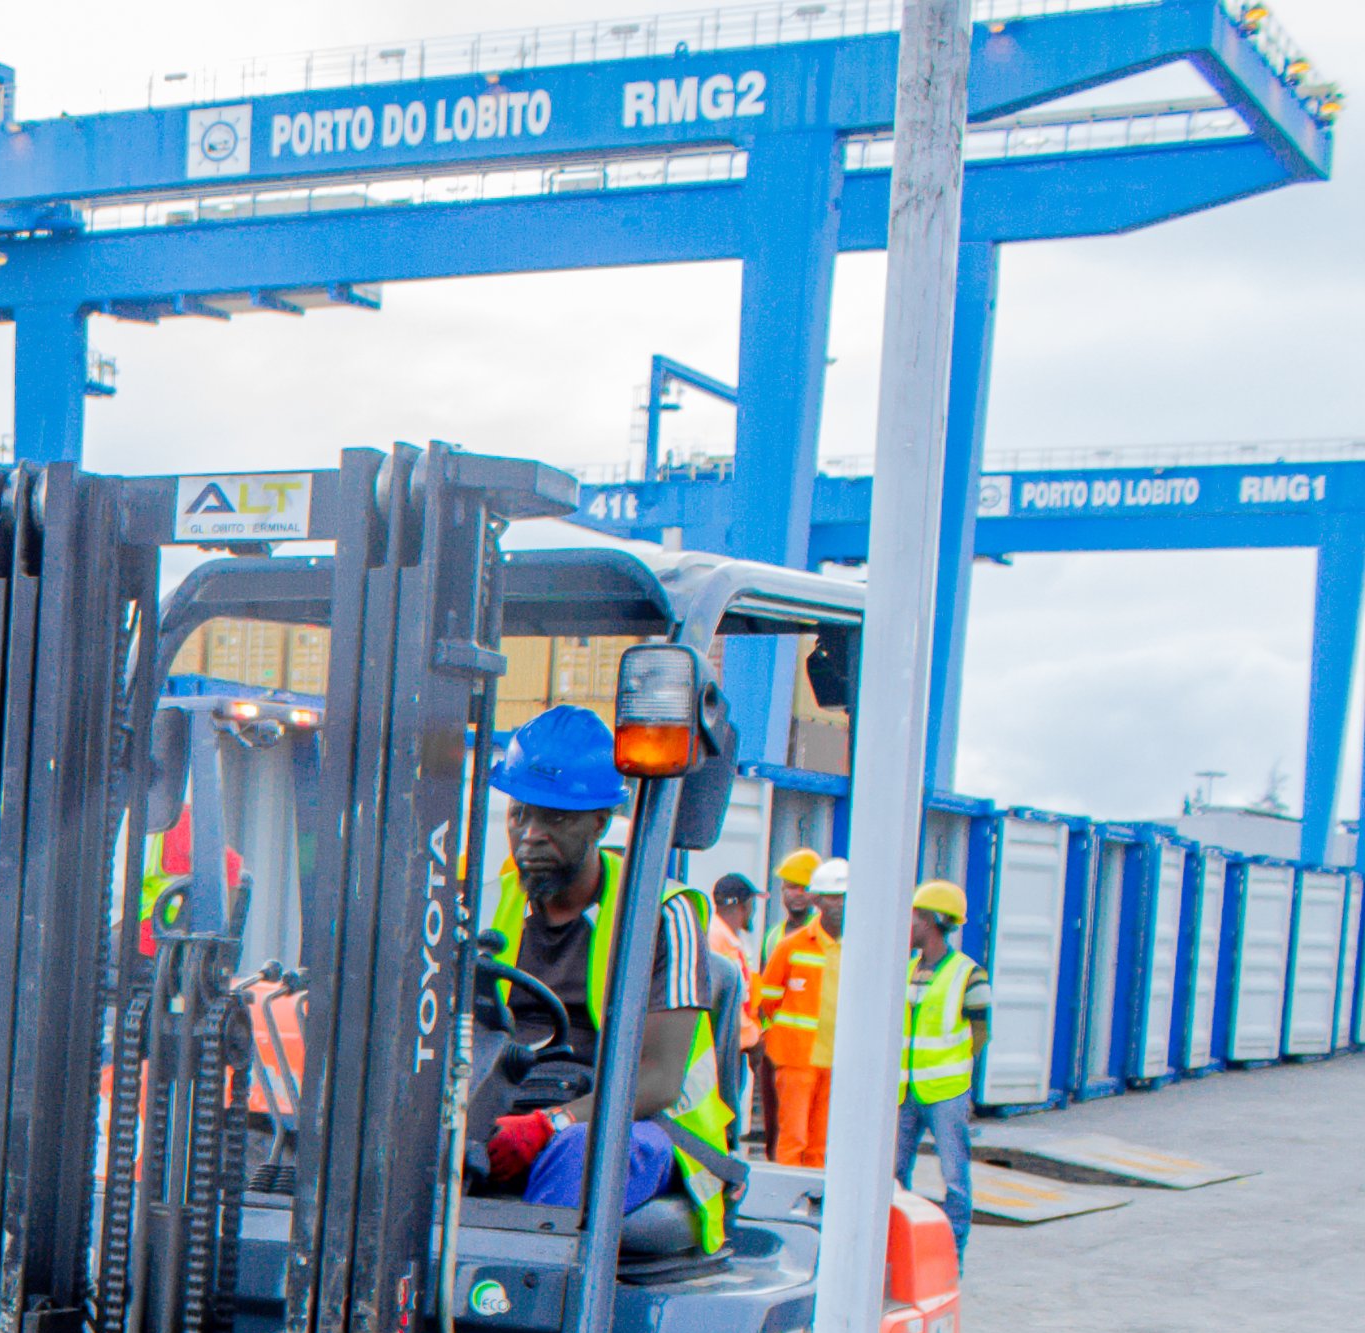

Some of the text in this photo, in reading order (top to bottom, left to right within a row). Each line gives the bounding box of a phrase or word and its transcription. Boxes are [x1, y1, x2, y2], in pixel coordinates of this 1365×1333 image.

[622, 70, 767, 128] RMG2
[272, 89, 552, 157] PORTO DO LOBITO
[184, 481, 302, 514] ALT
[1021, 477, 1200, 509] PORTO DO LOBITO
[1239, 475, 1326, 503] RMG1
[588, 493, 638, 520] 41t
[413, 818, 449, 1074] TOYOTA
